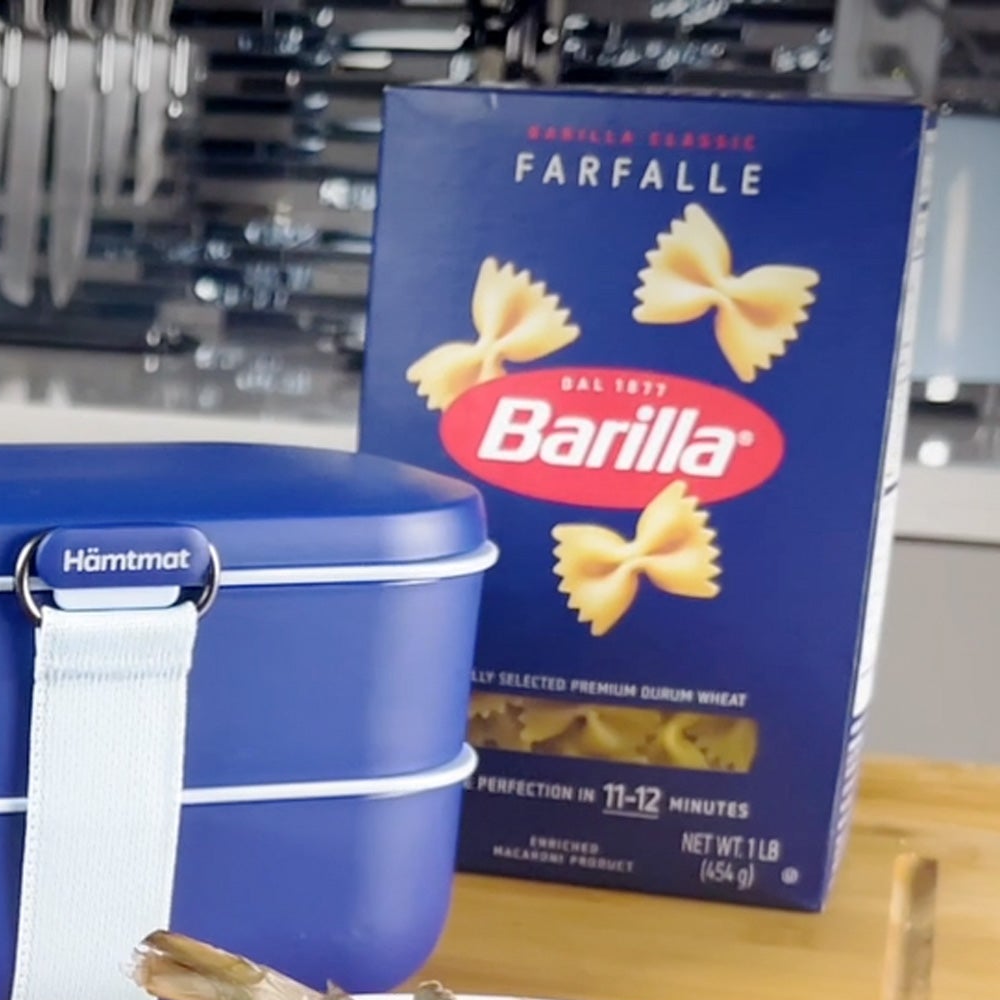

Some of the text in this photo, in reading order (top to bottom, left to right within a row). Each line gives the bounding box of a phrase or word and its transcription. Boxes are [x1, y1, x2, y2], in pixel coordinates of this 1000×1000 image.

[650, 130, 756, 152] CLASSIC
[514, 151, 763, 196] FARFALLE
[615, 378, 668, 398] 1877
[63, 547, 191, 573] Hämtmat
[498, 671, 567, 692] SELECTED
[570, 679, 637, 698] PREMIUM
[640, 685, 694, 703] DURUM
[697, 690, 747, 708] WHEAT
[477, 775, 574, 801] PERFECTION
[577, 787, 596, 803] IN
[603, 782, 662, 814] 11-12
[669, 796, 750, 820] MINUTES
[493, 845, 635, 873] MACARONI PRODUCT
[530, 835, 600, 855] ENRICHED
[681, 831, 781, 863] NET WT. 1 LB
[700, 858, 756, 892] (454 g)
